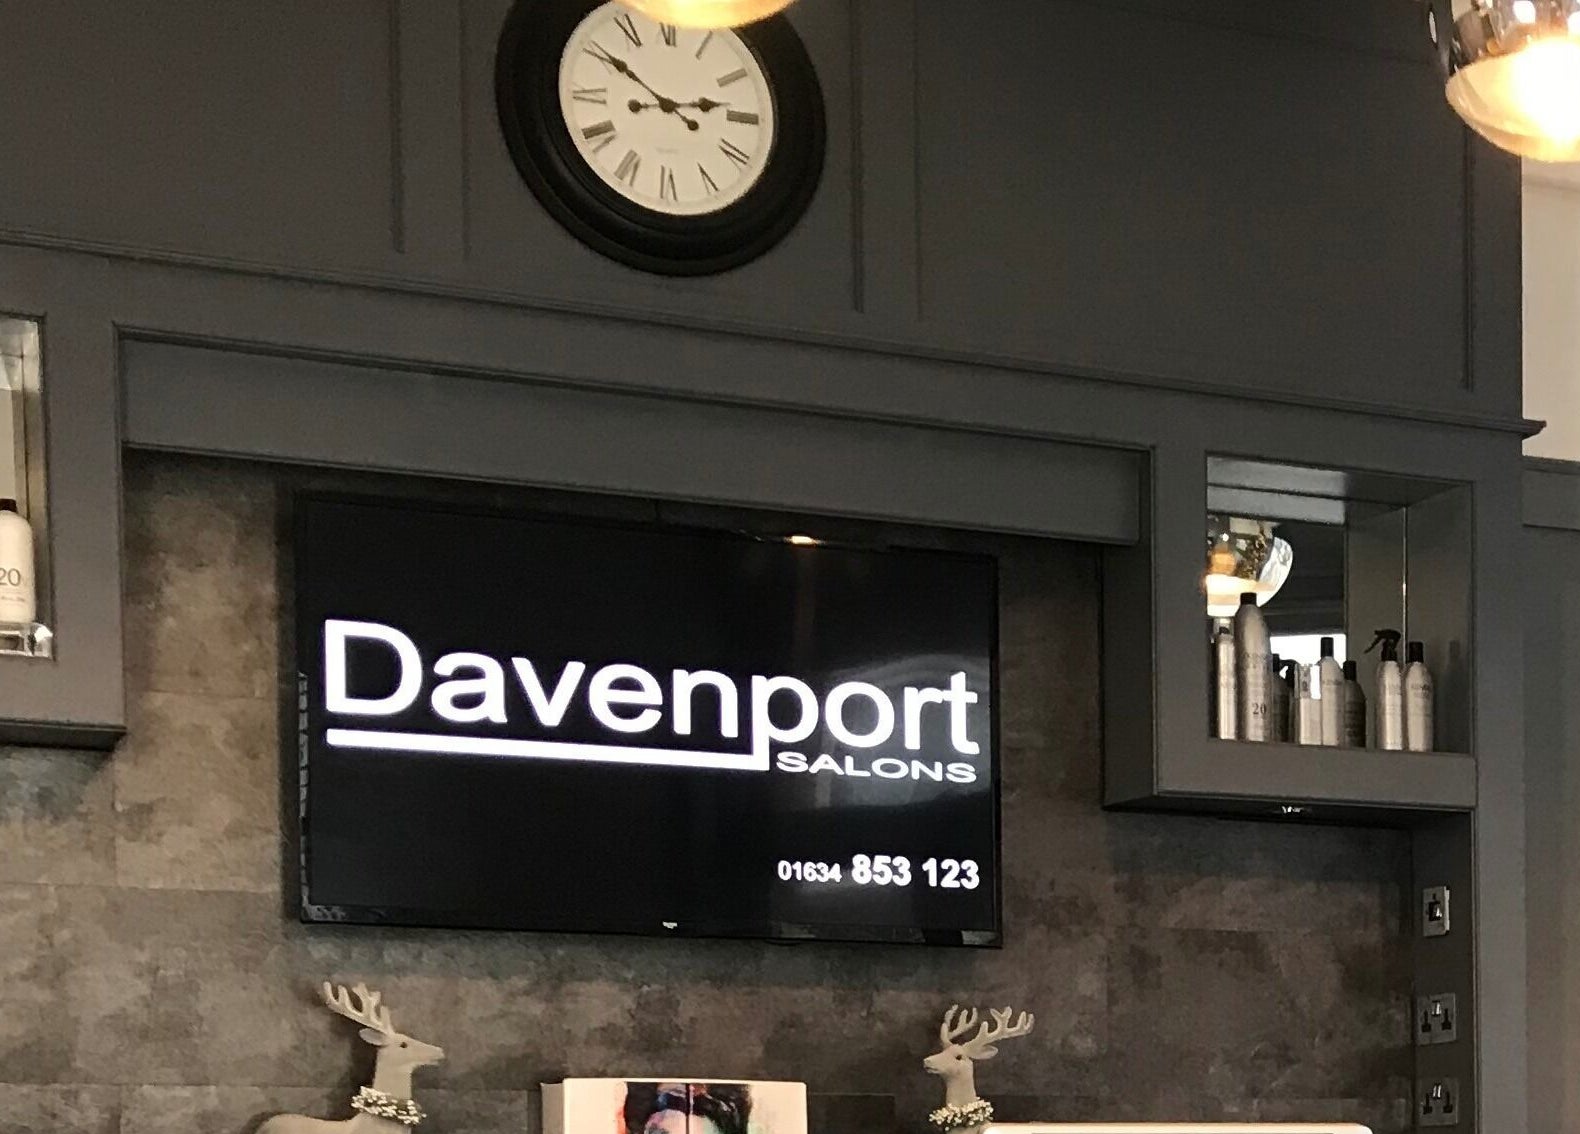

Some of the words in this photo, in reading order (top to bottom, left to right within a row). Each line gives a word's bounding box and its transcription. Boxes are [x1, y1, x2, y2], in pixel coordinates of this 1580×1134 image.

[324, 618, 980, 771] Davenport
[1252, 702, 1267, 717] 20
[776, 751, 977, 783] SALONS
[777, 859, 843, 883] 01634
[851, 853, 912, 887] 853
[922, 857, 980, 890] 123
